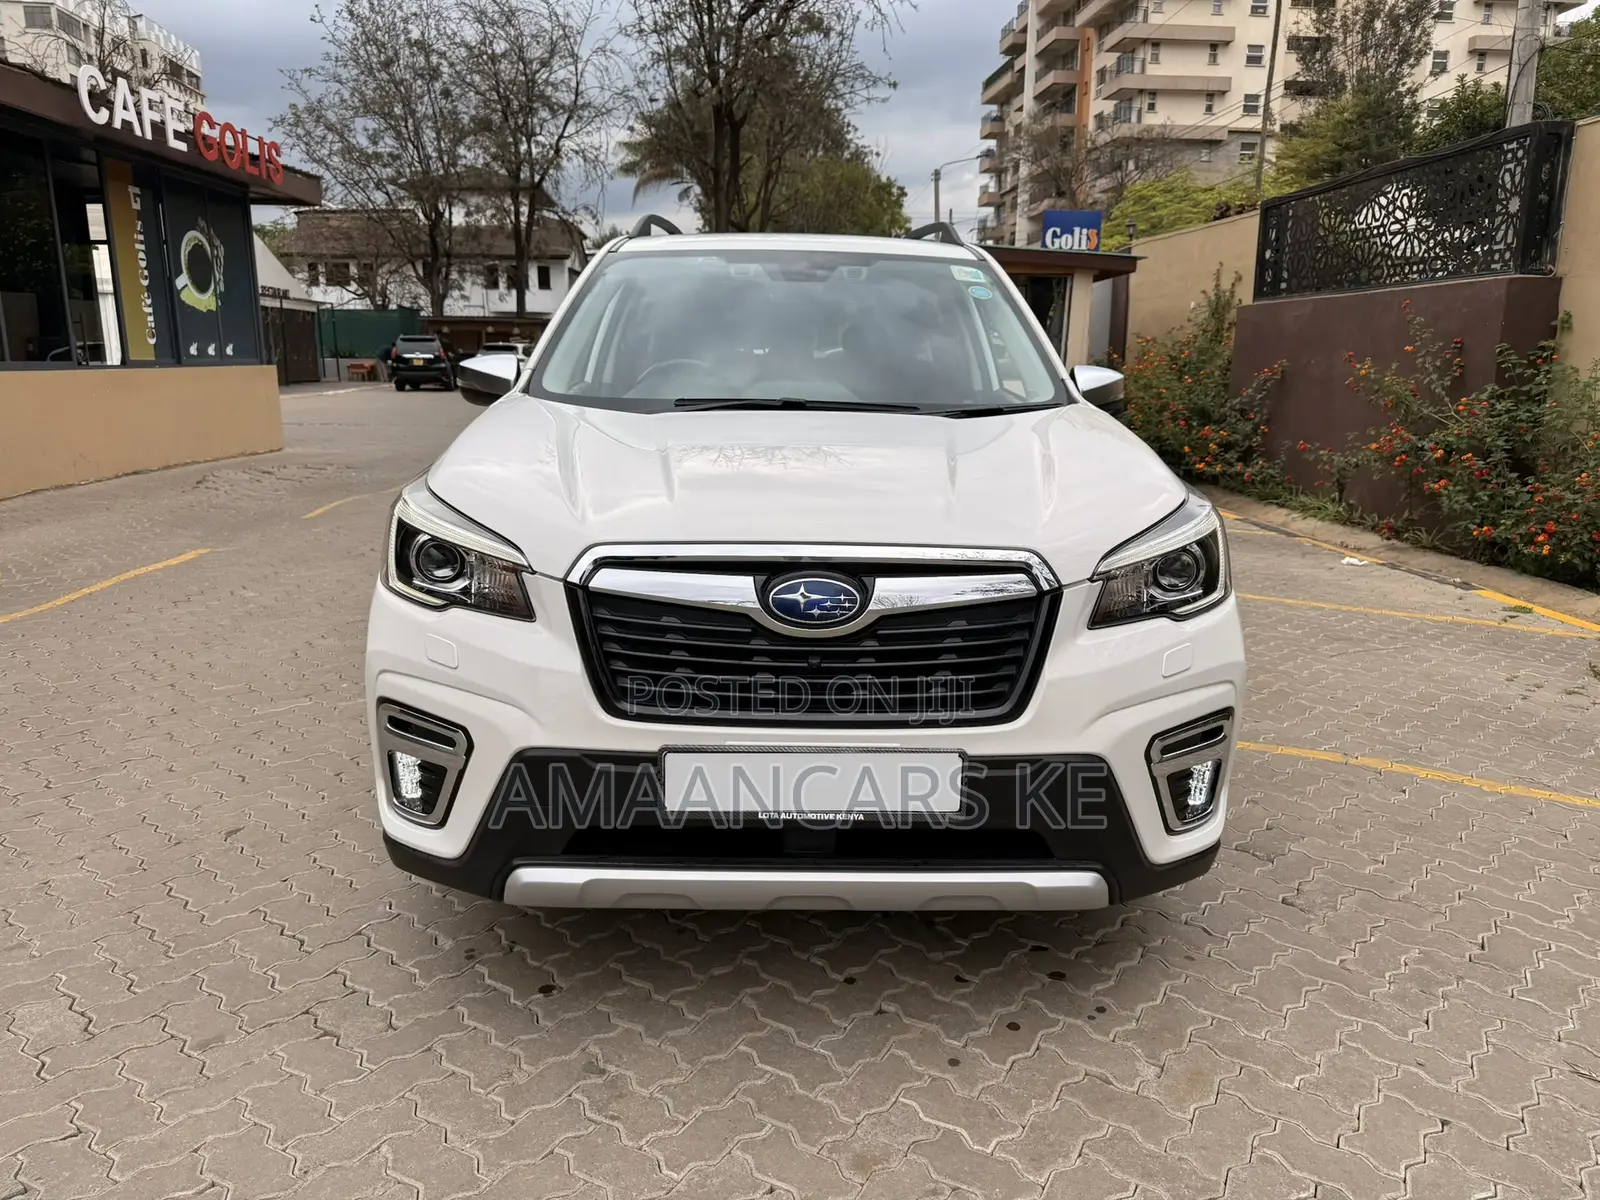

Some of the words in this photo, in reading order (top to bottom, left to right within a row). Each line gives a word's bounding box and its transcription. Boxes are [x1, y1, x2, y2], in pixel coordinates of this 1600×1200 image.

[77, 64, 188, 152] CAFE
[194, 111, 284, 185] GOLIS
[1045, 226, 1098, 250] Golis
[780, 812, 835, 820] AUTOMOTIVE
[836, 812, 864, 821] KENYA
